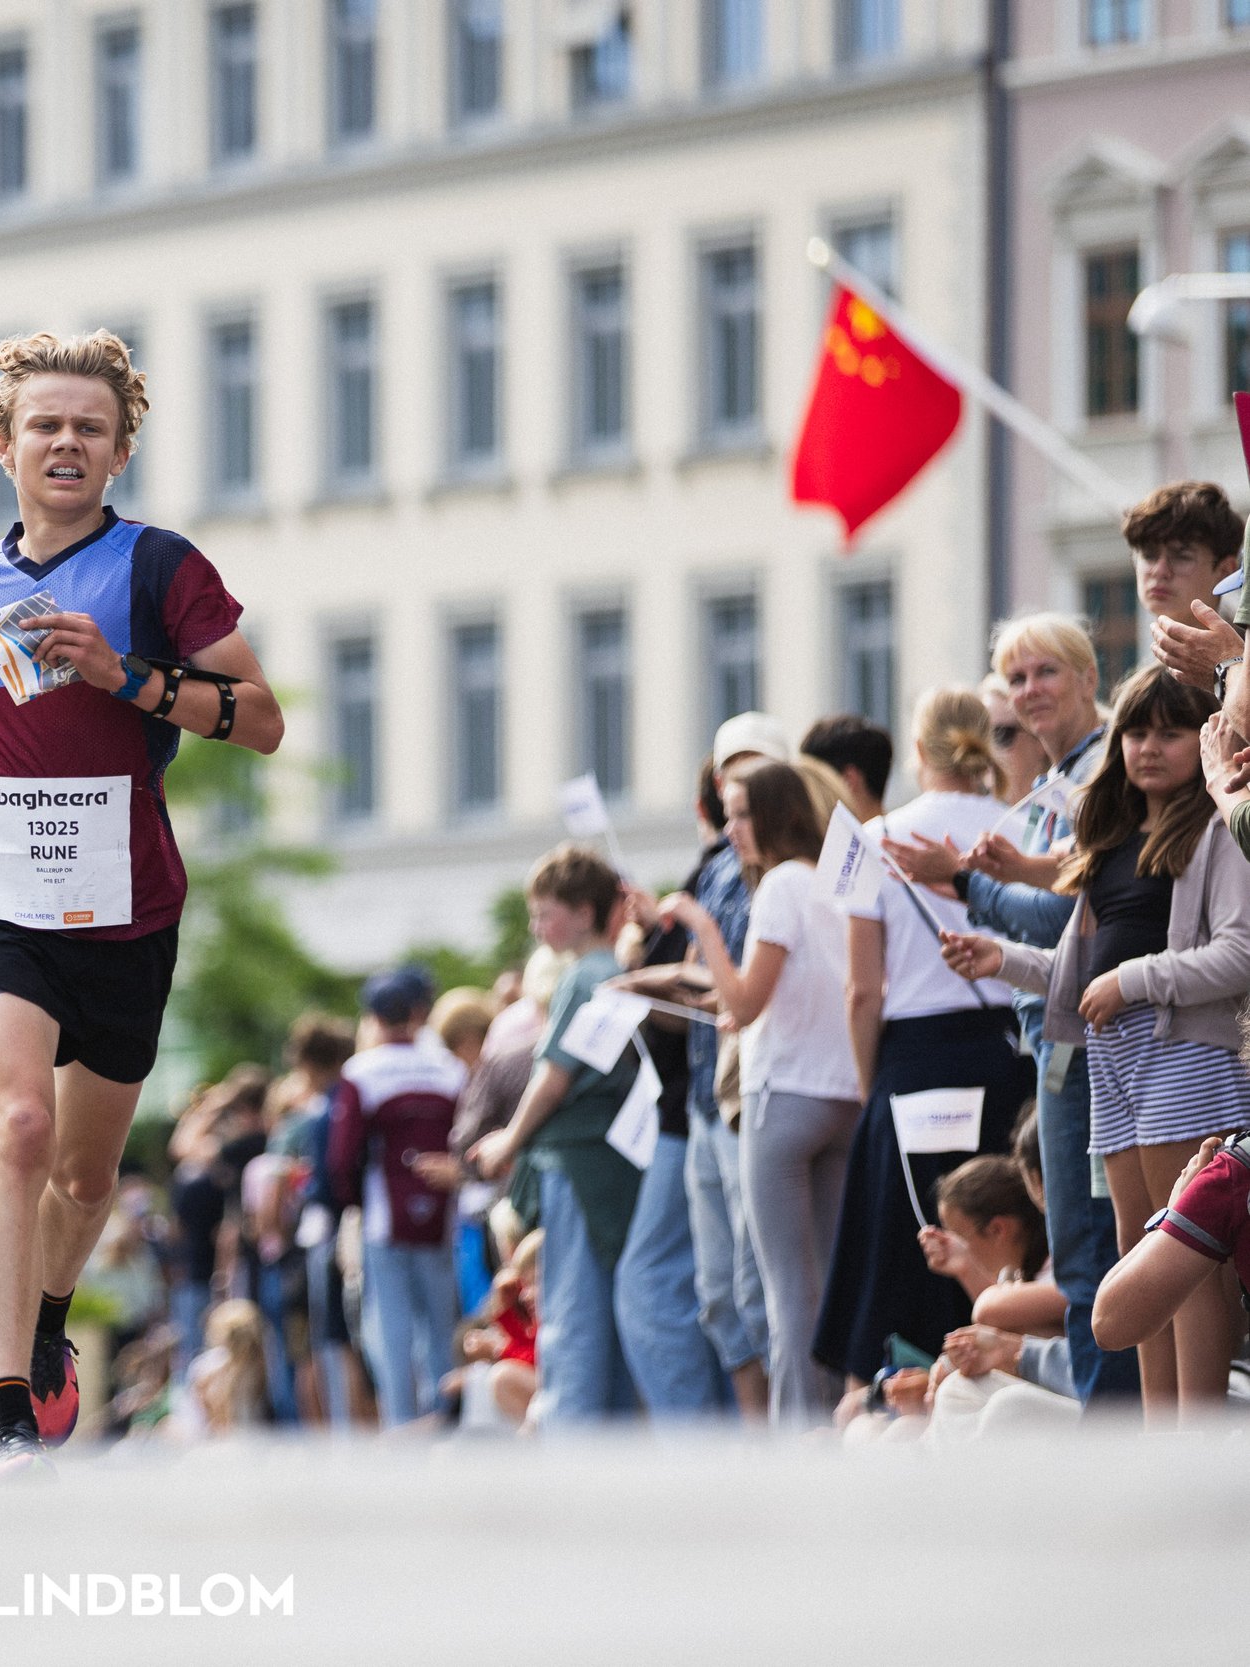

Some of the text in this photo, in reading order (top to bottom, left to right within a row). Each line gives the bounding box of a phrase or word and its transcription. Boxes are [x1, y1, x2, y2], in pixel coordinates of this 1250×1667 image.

[27, 821, 79, 836] 13025
[30, 845, 78, 860] RUNE
[14, 912, 55, 920] CHALMERS
